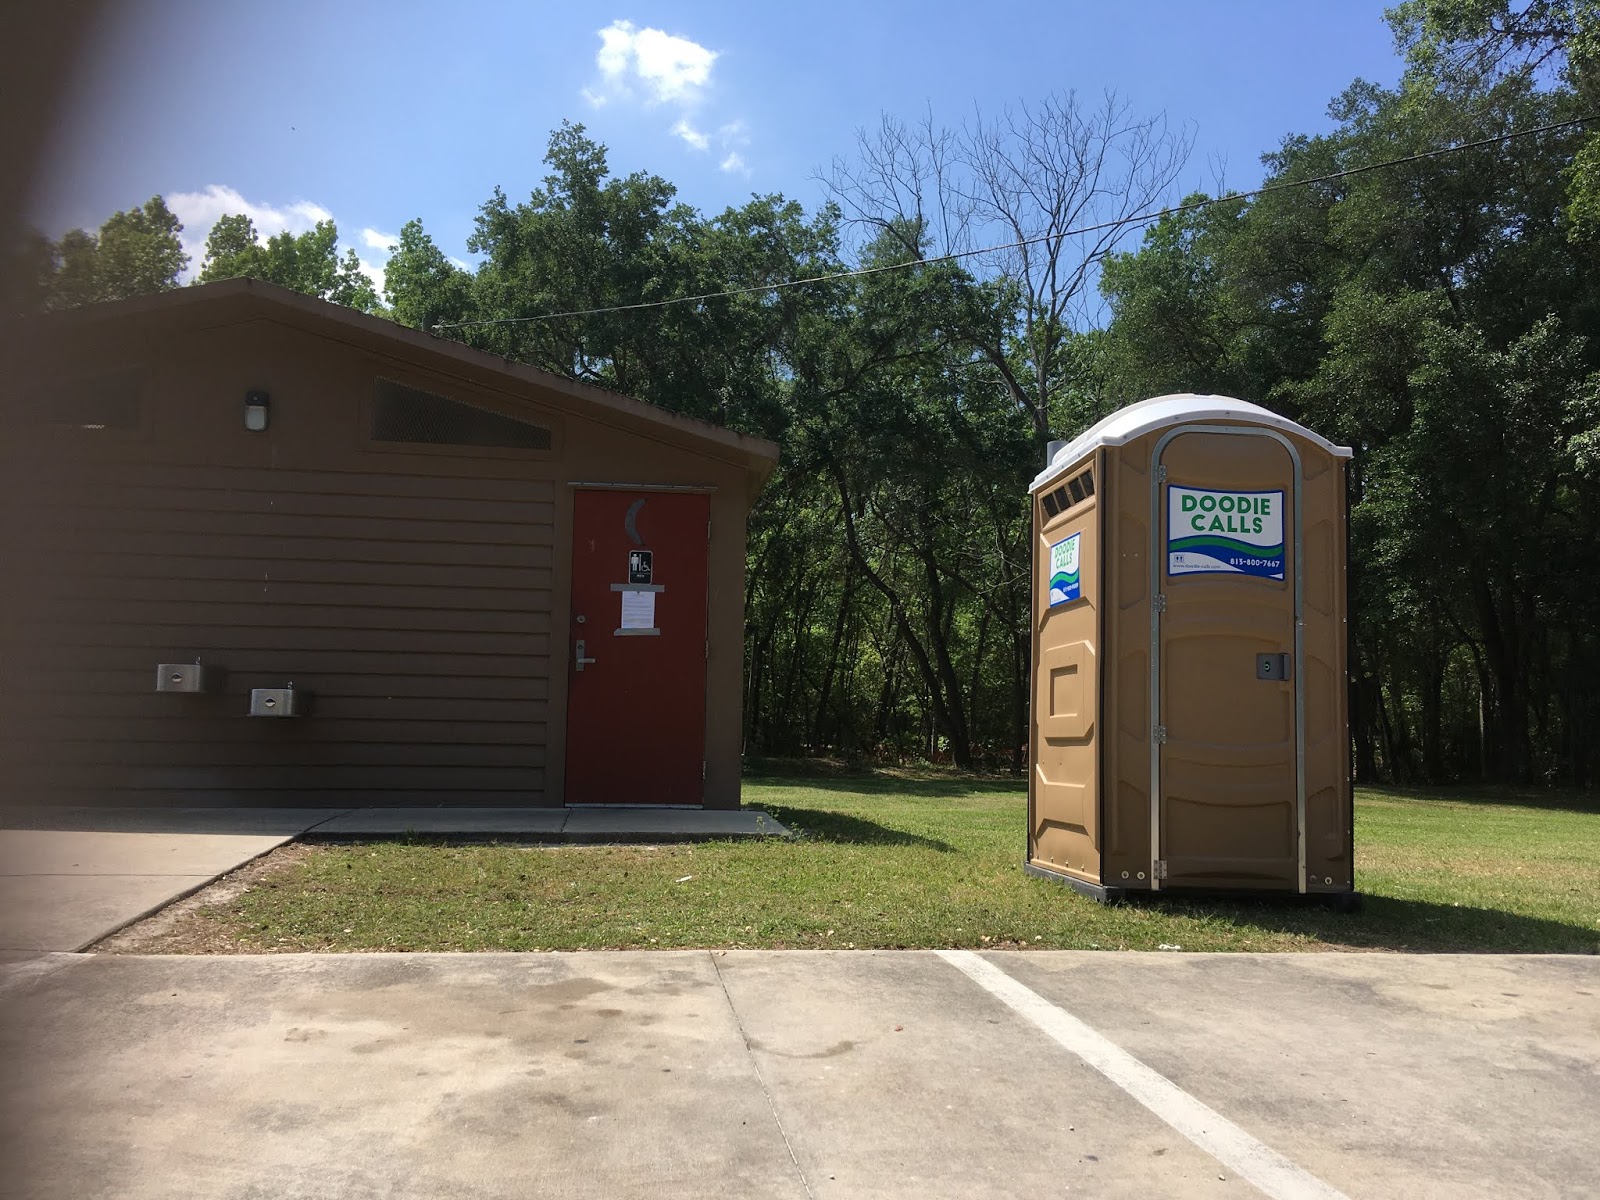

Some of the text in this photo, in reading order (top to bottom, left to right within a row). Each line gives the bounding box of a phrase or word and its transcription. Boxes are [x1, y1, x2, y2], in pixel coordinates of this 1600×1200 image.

[1182, 495, 1270, 515] DOODIE
[1191, 514, 1263, 534] CALLS
[1054, 538, 1076, 558] DOODIE
[1056, 552, 1073, 569] CALLS
